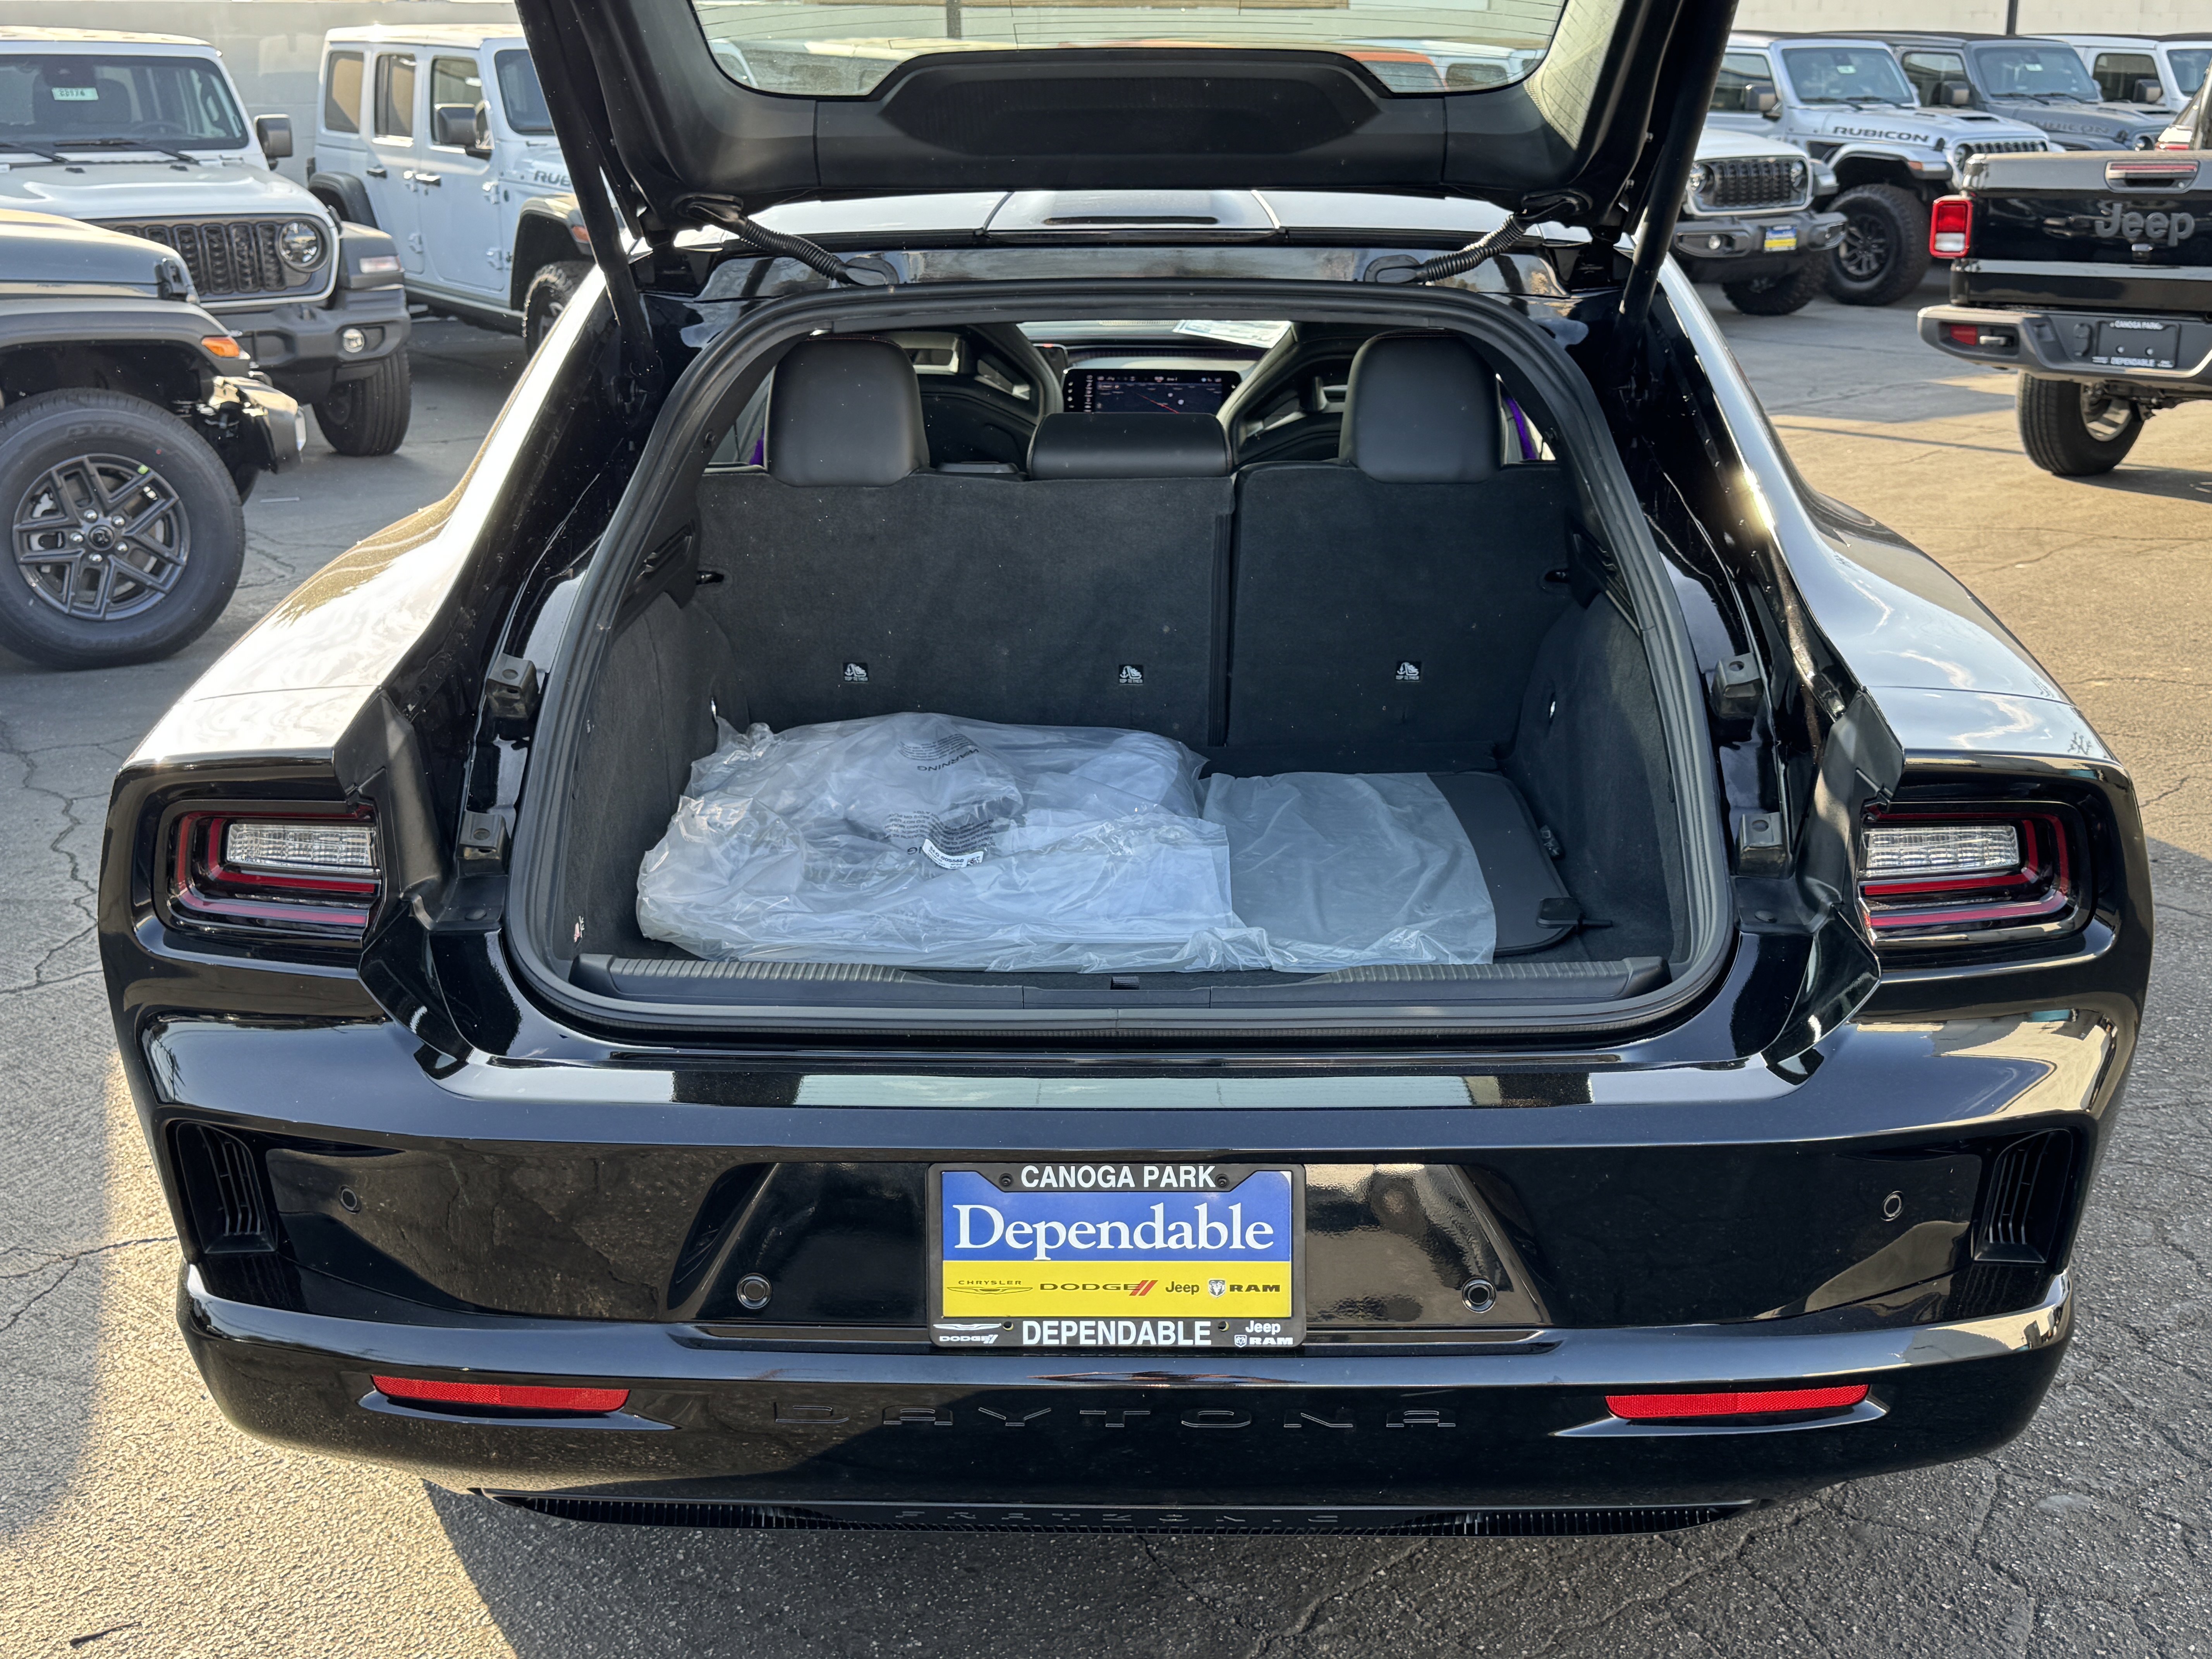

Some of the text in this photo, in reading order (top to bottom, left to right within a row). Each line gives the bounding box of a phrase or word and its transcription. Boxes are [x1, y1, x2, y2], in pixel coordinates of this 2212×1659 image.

[1833, 126, 1929, 143] RUBICON
[2095, 203, 2195, 247] Jeep
[917, 749, 979, 771] WARNING
[1021, 1165, 1216, 1188] CANOGA PARK
[953, 1202, 1274, 1261] Dependable
[1165, 1281, 1200, 1295] Jeep
[1229, 1284, 1281, 1292] RAM
[1022, 1321, 1212, 1345] DEPENDABLE
[1245, 1320, 1281, 1335] Jeep
[1249, 1337, 1293, 1345] RAM
[774, 1402, 1456, 1428] DAYTONA
